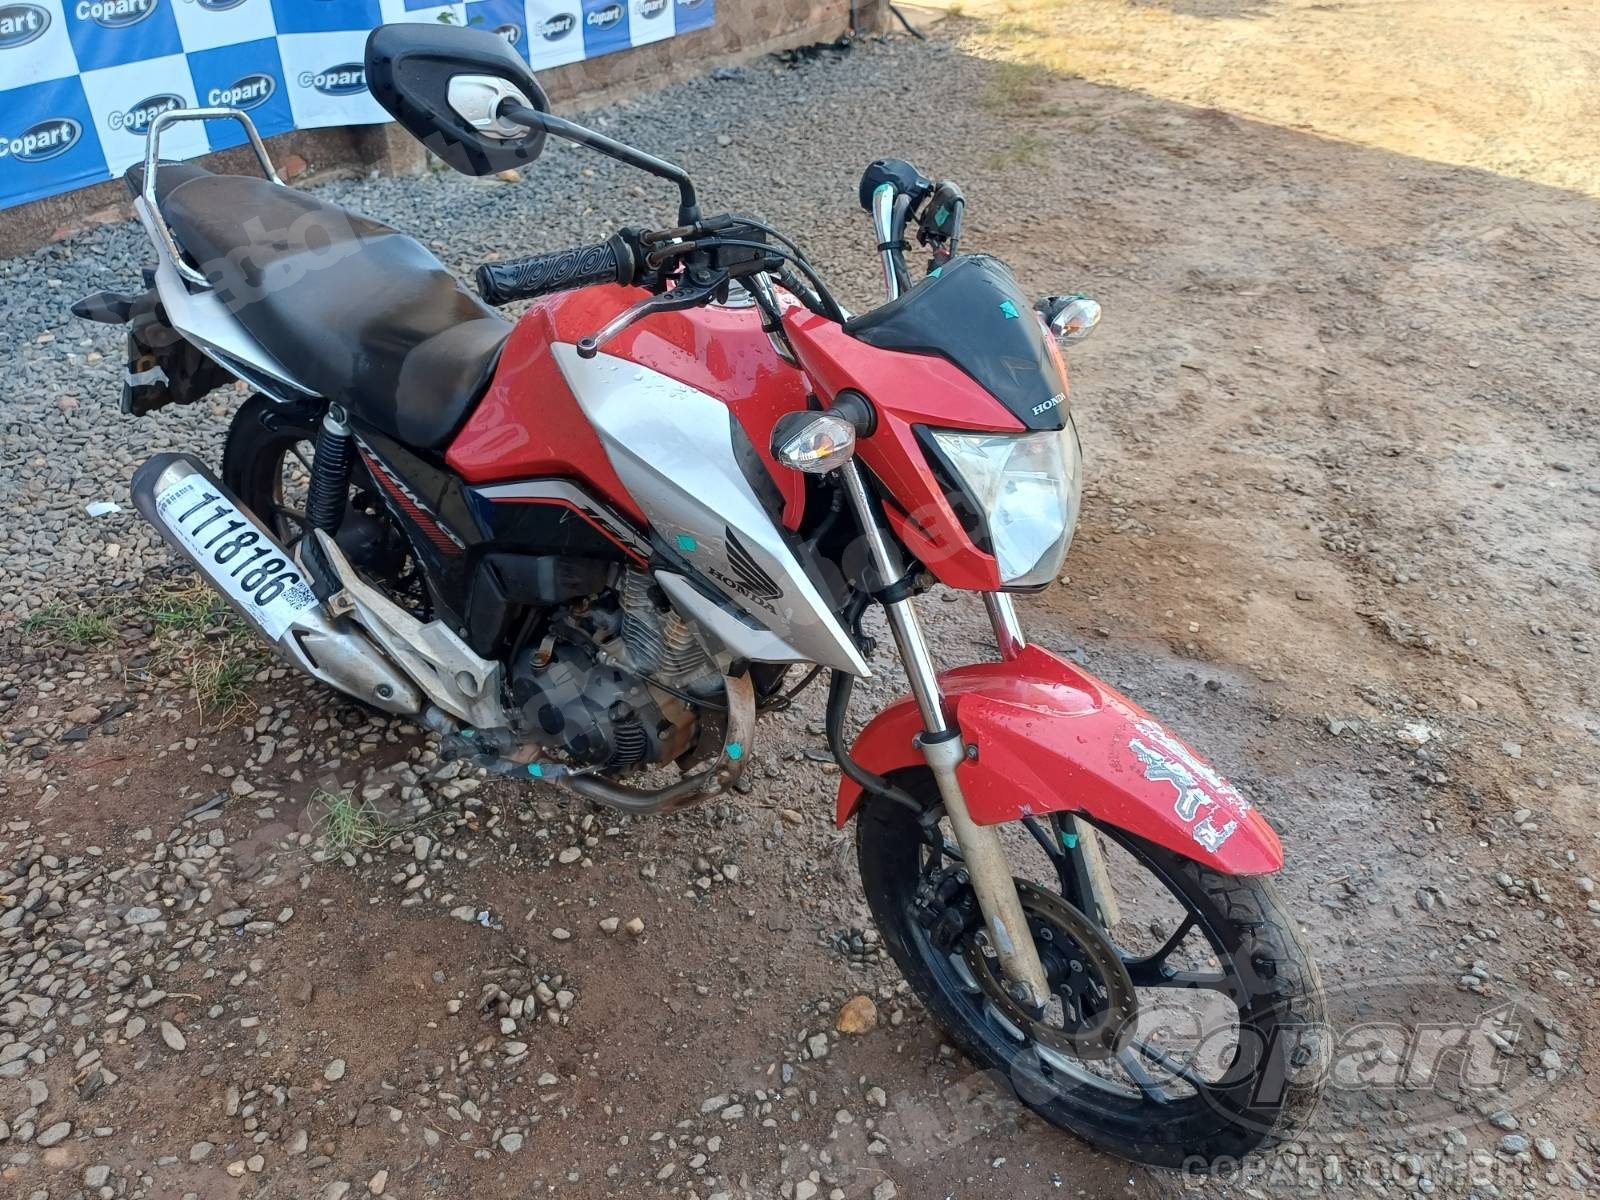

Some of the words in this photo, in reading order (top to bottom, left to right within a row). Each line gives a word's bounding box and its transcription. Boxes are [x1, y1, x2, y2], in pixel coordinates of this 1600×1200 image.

[0, 10, 37, 34] art
[208, 78, 267, 107] Copart
[0, 122, 71, 157] Copart
[177, 492, 301, 607] 1118186
[708, 566, 780, 616] HONDA
